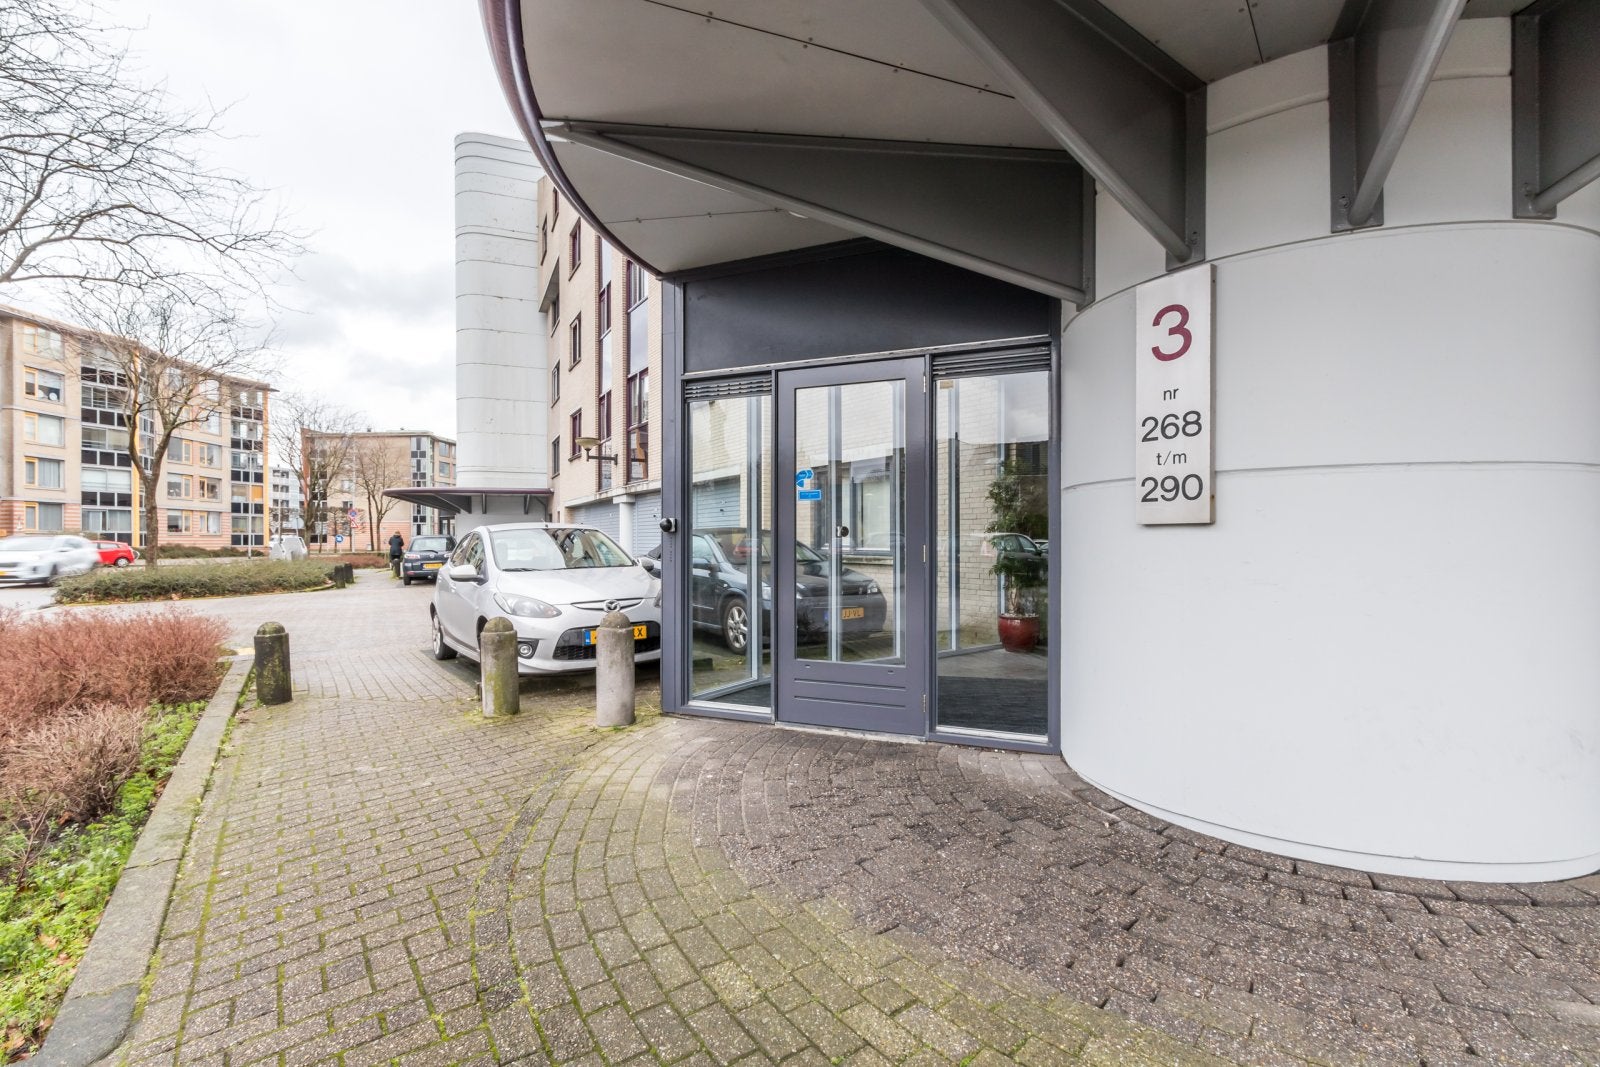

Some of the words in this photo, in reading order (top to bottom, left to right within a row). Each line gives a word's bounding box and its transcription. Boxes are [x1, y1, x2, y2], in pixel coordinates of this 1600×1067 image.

[1151, 303, 1193, 362] 3
[1163, 387, 1180, 401] nr
[1141, 410, 1203, 443] 268
[1156, 450, 1187, 466] t/m
[1140, 473, 1204, 503] 290
